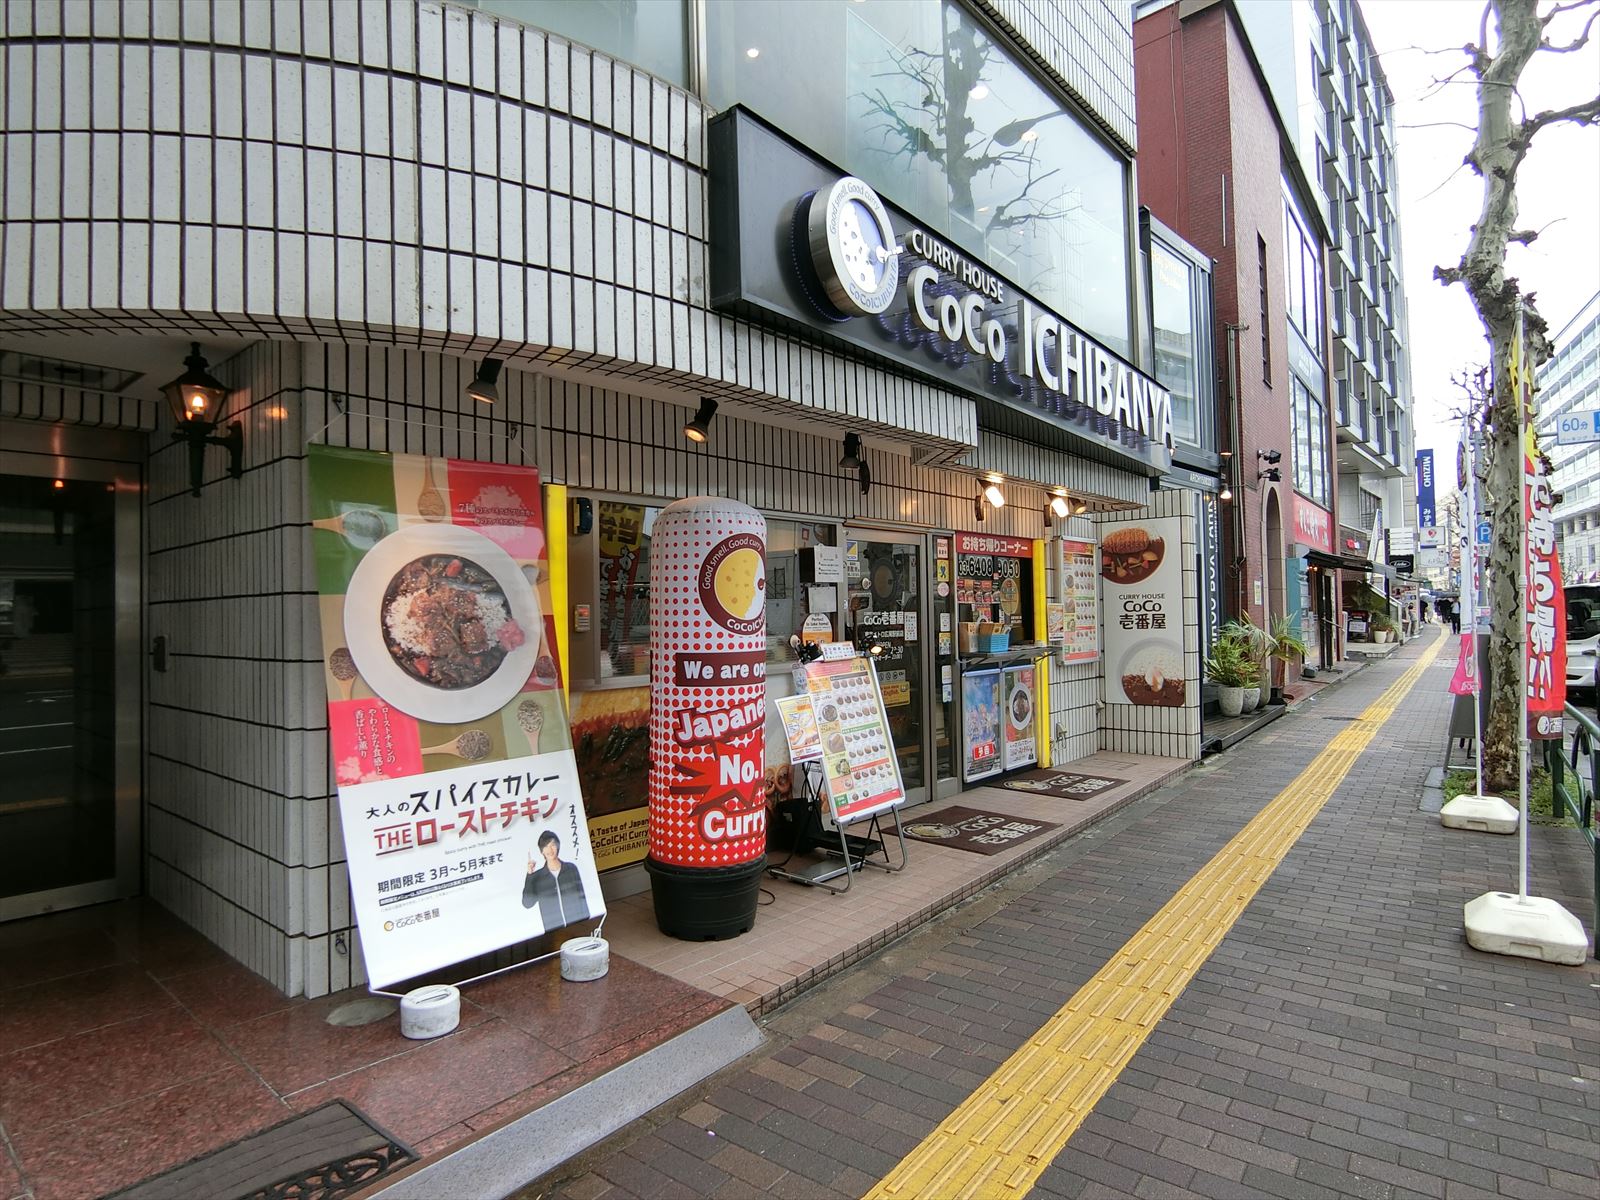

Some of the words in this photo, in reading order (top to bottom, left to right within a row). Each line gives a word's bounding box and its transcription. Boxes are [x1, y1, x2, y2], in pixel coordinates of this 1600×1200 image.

[911, 231, 959, 275] CURRY
[962, 259, 1003, 303] HOUSE
[910, 265, 1006, 363] CoCo
[1021, 299, 1175, 448] ICHIBANYA
[1422, 456, 1432, 488] MIZUHO
[600, 516, 640, 545] 弁当
[962, 536, 1028, 554] お持ち帰りコーナー
[702, 564, 714, 590] Good
[728, 537, 749, 550] Good
[749, 538, 763, 551] curry
[1123, 600, 1162, 613] CoCo
[1119, 613, 1166, 630] 壱番屋
[683, 660, 714, 679] We
[720, 662, 749, 679] are
[753, 662, 766, 678] op
[678, 698, 765, 742] Japane
[719, 748, 765, 786] No.1
[366, 771, 560, 820] 大人のスパイスカレー
[374, 827, 414, 850] THE
[415, 795, 559, 847] ローストチキン
[590, 829, 596, 838] A
[597, 824, 618, 836] Taste
[620, 822, 627, 830] of
[629, 829, 649, 840] Curry
[703, 807, 766, 840] Curry
[960, 815, 1006, 832] CoCo
[968, 821, 1043, 845] 壱番屋
[377, 872, 426, 894] 期間限定
